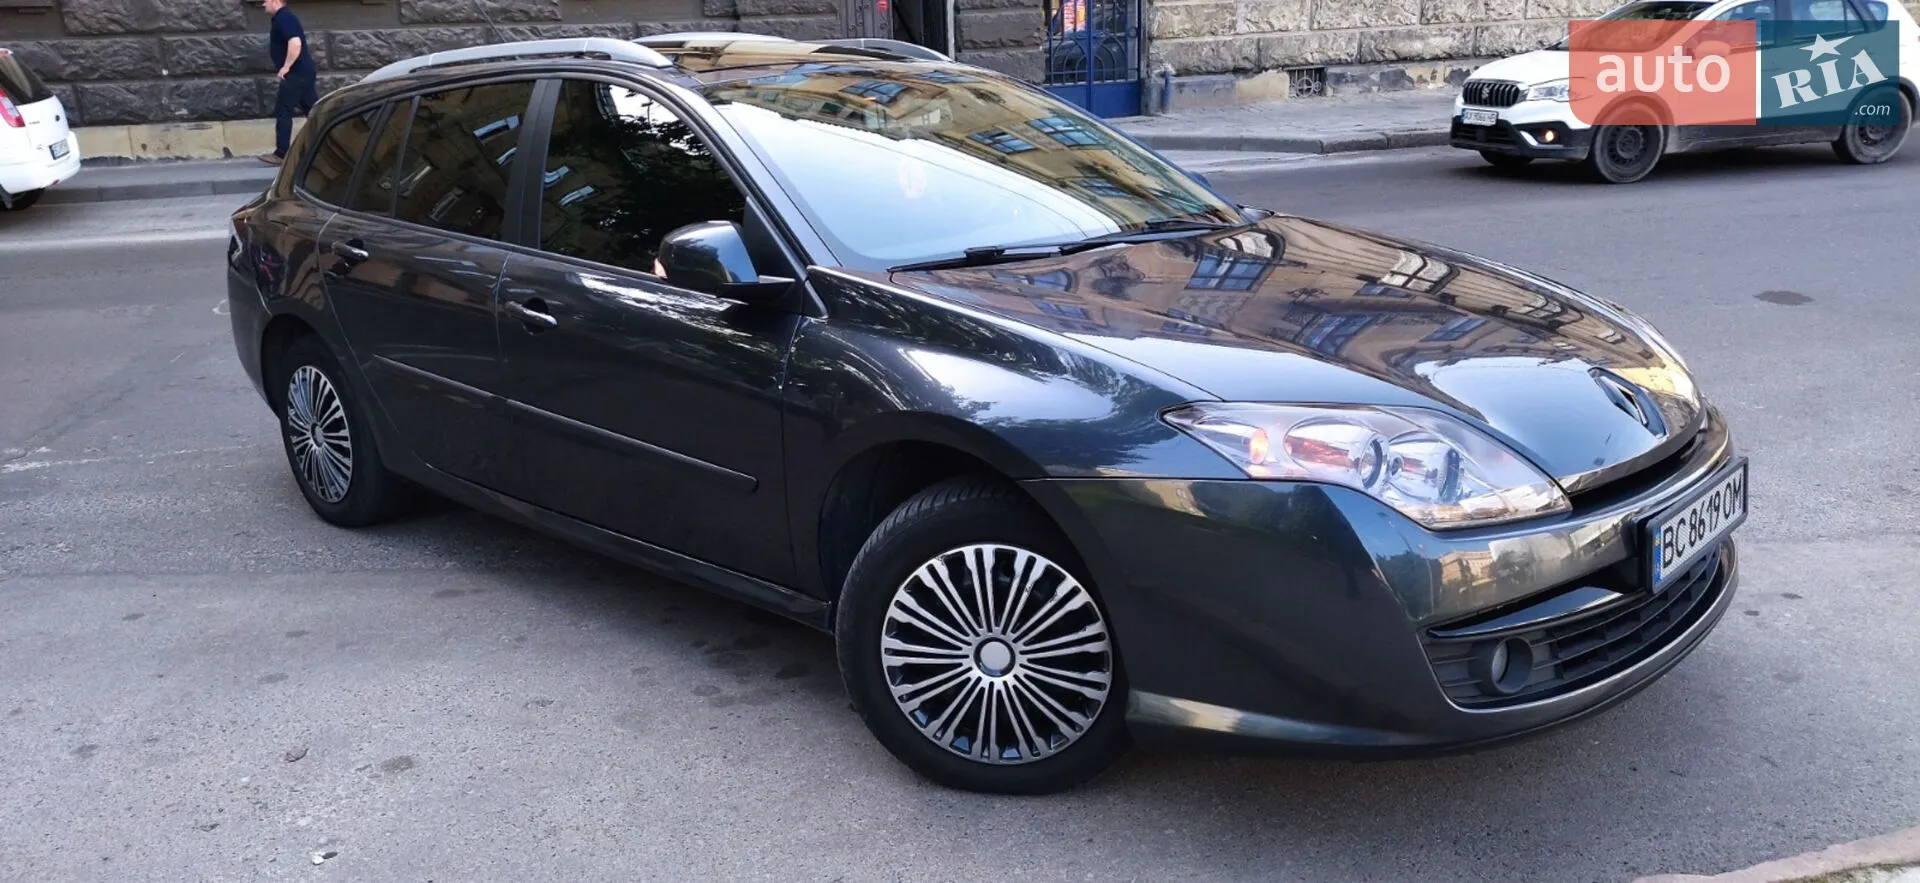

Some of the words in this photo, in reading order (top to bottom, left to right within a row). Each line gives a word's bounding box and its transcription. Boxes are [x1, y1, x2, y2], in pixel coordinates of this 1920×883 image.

[1662, 517, 1686, 569] BC
[1689, 490, 1721, 548] 8619
[1723, 472, 1742, 520] OM
